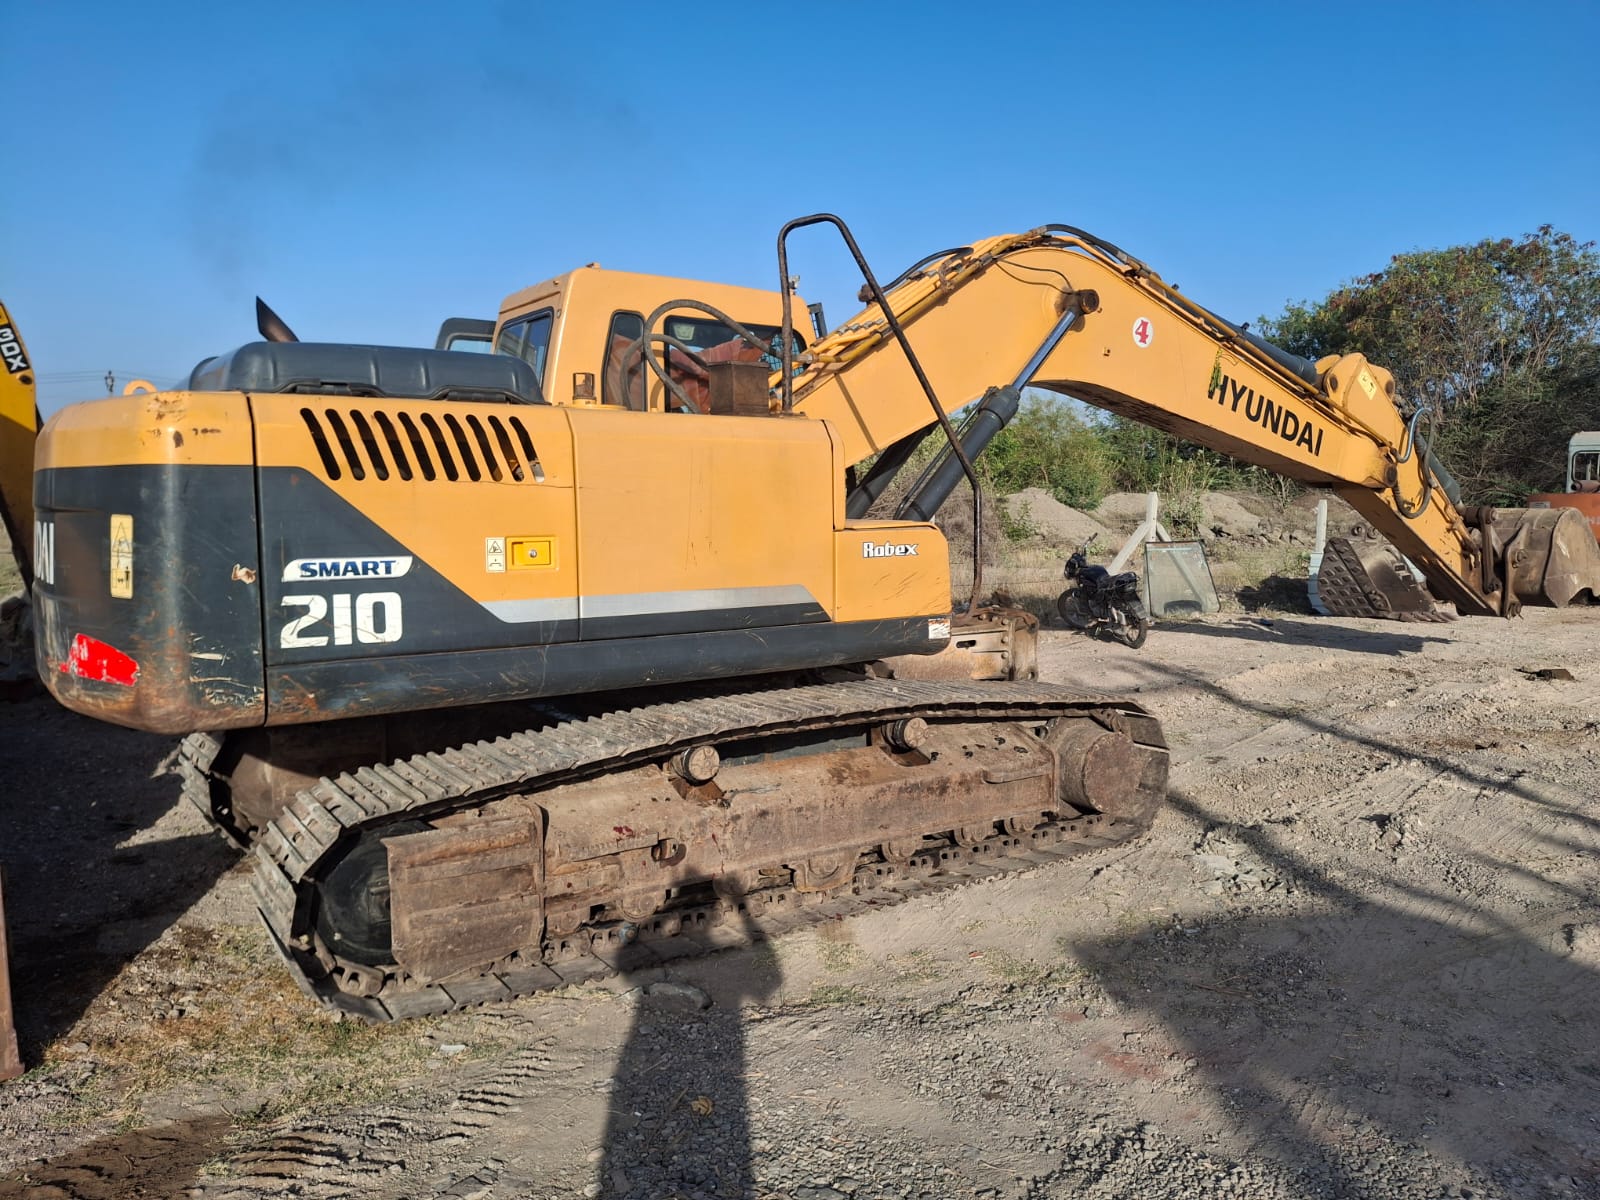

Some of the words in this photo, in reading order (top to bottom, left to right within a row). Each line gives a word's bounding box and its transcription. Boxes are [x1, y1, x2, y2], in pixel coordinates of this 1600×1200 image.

[1134, 318, 1150, 345] 4
[1207, 374, 1324, 457] HYUNDAI
[863, 541, 919, 558] Robex
[299, 560, 397, 578] SMART
[280, 591, 404, 649] 210
